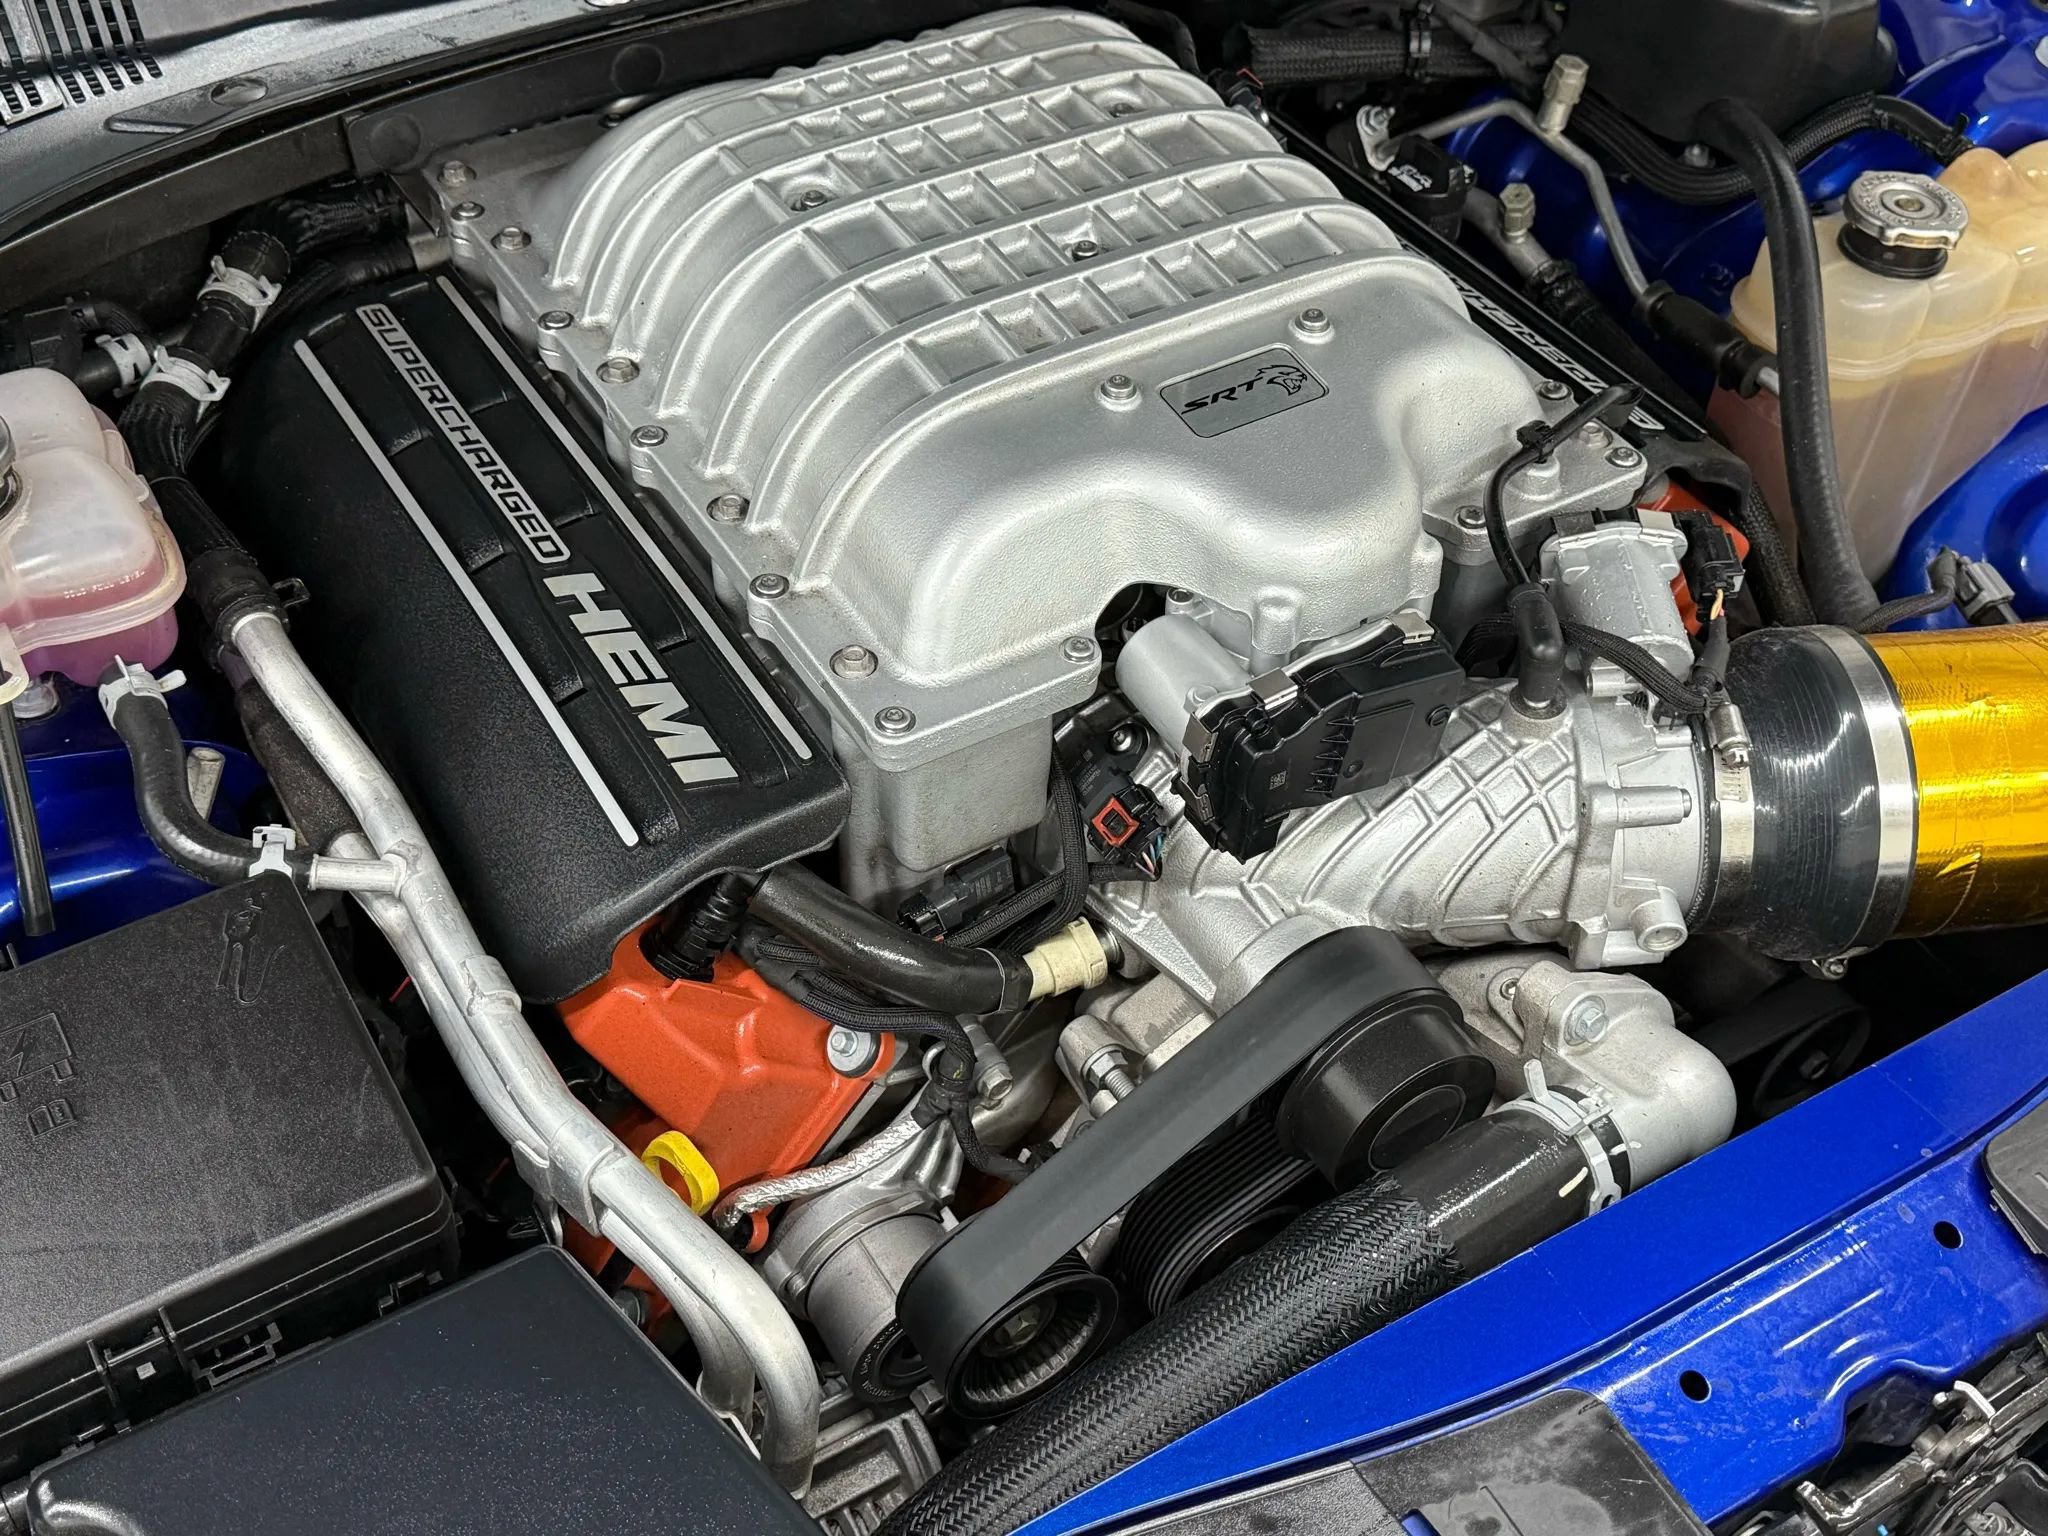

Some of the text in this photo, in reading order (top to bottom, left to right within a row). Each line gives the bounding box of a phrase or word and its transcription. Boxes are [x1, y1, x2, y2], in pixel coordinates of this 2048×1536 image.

[1181, 377, 1263, 415] SRT
[358, 305, 740, 785] SUPERCHARGED HEMI
